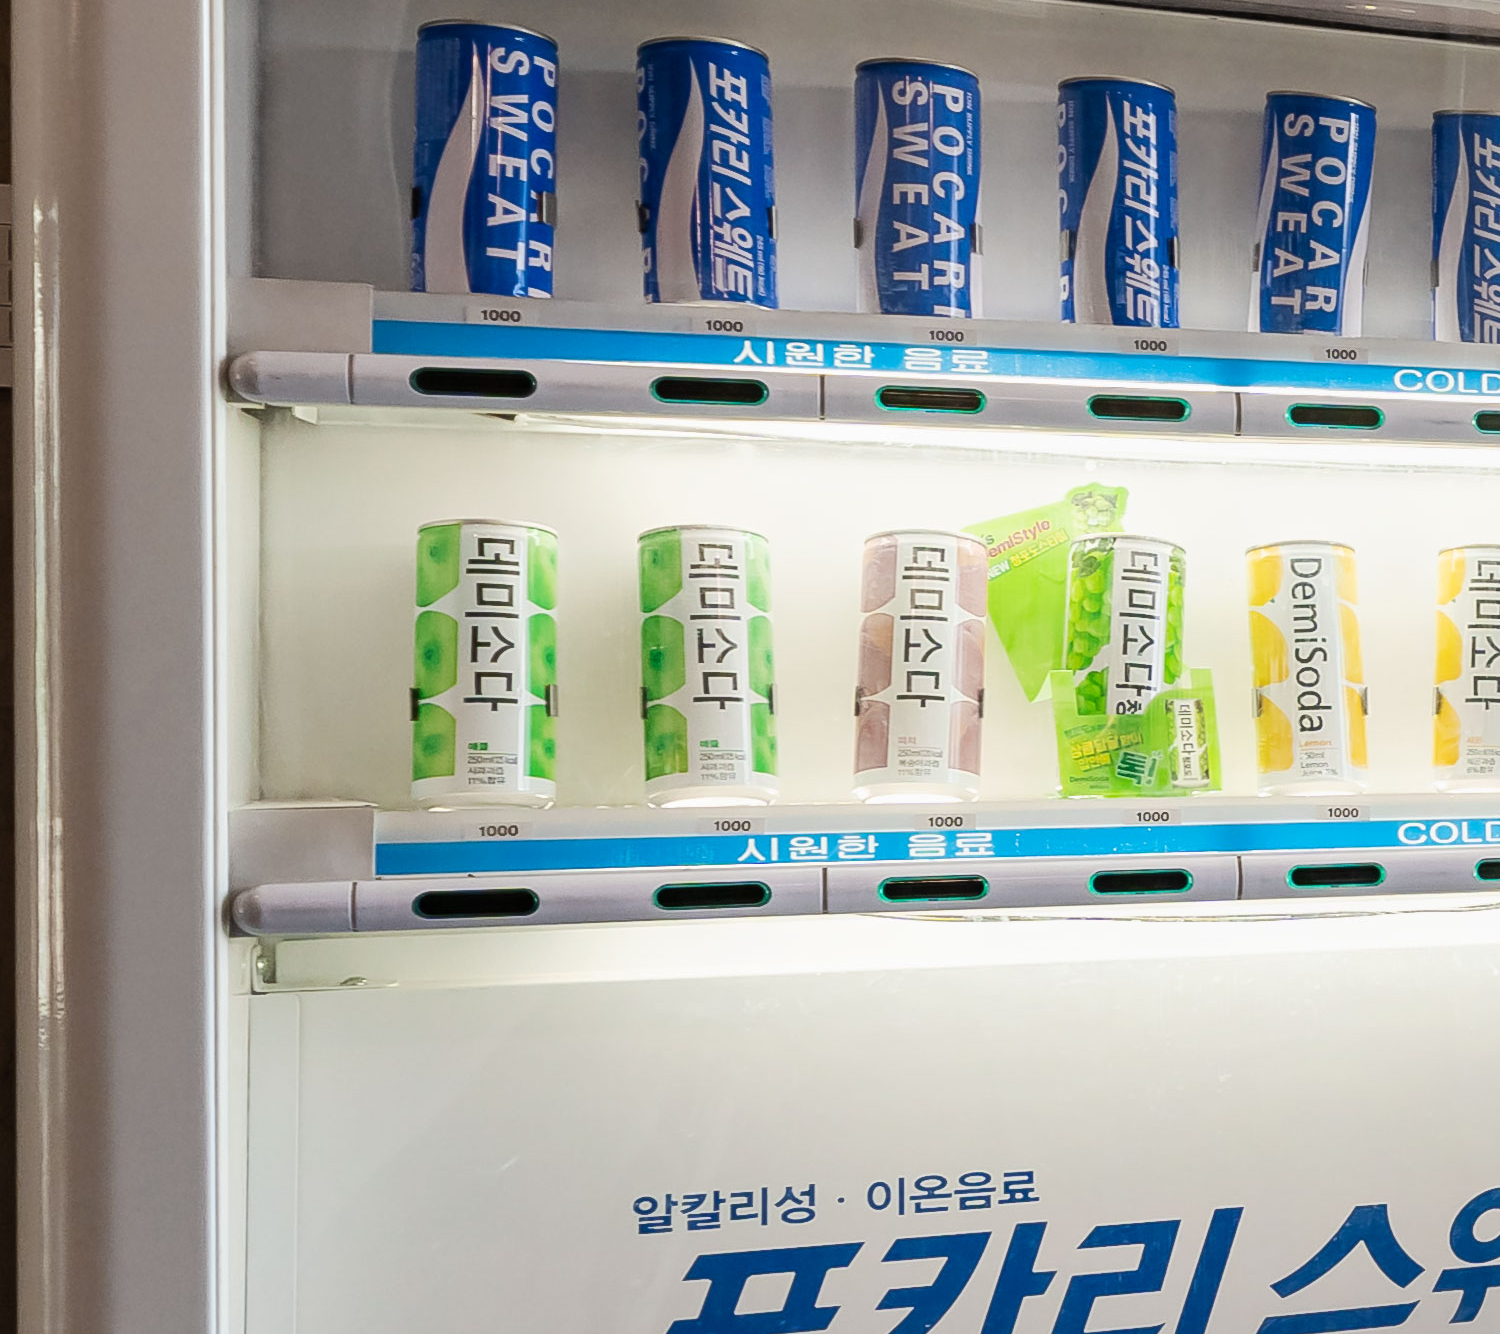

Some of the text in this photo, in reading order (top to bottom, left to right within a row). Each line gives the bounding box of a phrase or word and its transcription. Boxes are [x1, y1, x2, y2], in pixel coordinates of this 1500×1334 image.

[486, 46, 531, 272] SWEAT
[709, 61, 755, 301] 포카리 스웨트
[891, 78, 931, 291] SWEAT
[931, 84, 966, 319] POCARI
[1123, 100, 1162, 328] 포카리 스웨트
[1270, 112, 1315, 315] SWEAT
[481, 309, 521, 323] 1000
[705, 319, 743, 332] 1000
[928, 329, 964, 342] 1000
[733, 340, 990, 373] 시원한 음료
[1133, 339, 1167, 352] 1000
[1325, 348, 1357, 360] 1000
[988, 519, 1051, 558] emiStyle
[463, 537, 521, 712] 데미소다
[688, 543, 744, 711] 데미소다
[896, 546, 950, 708] 데미소다
[1115, 550, 1162, 697] 데미소다
[1289, 557, 1332, 733] DemiSoda
[1178, 704, 1196, 756] 데미소다
[478, 825, 519, 838] 1000
[713, 820, 751, 833] 1000
[928, 815, 963, 828] 1000
[1136, 811, 1170, 823] 1000
[1327, 807, 1359, 819] 1000
[737, 832, 995, 863] 시원한 음료
[632, 1169, 1041, 1235] 알칼리성 이온음료
